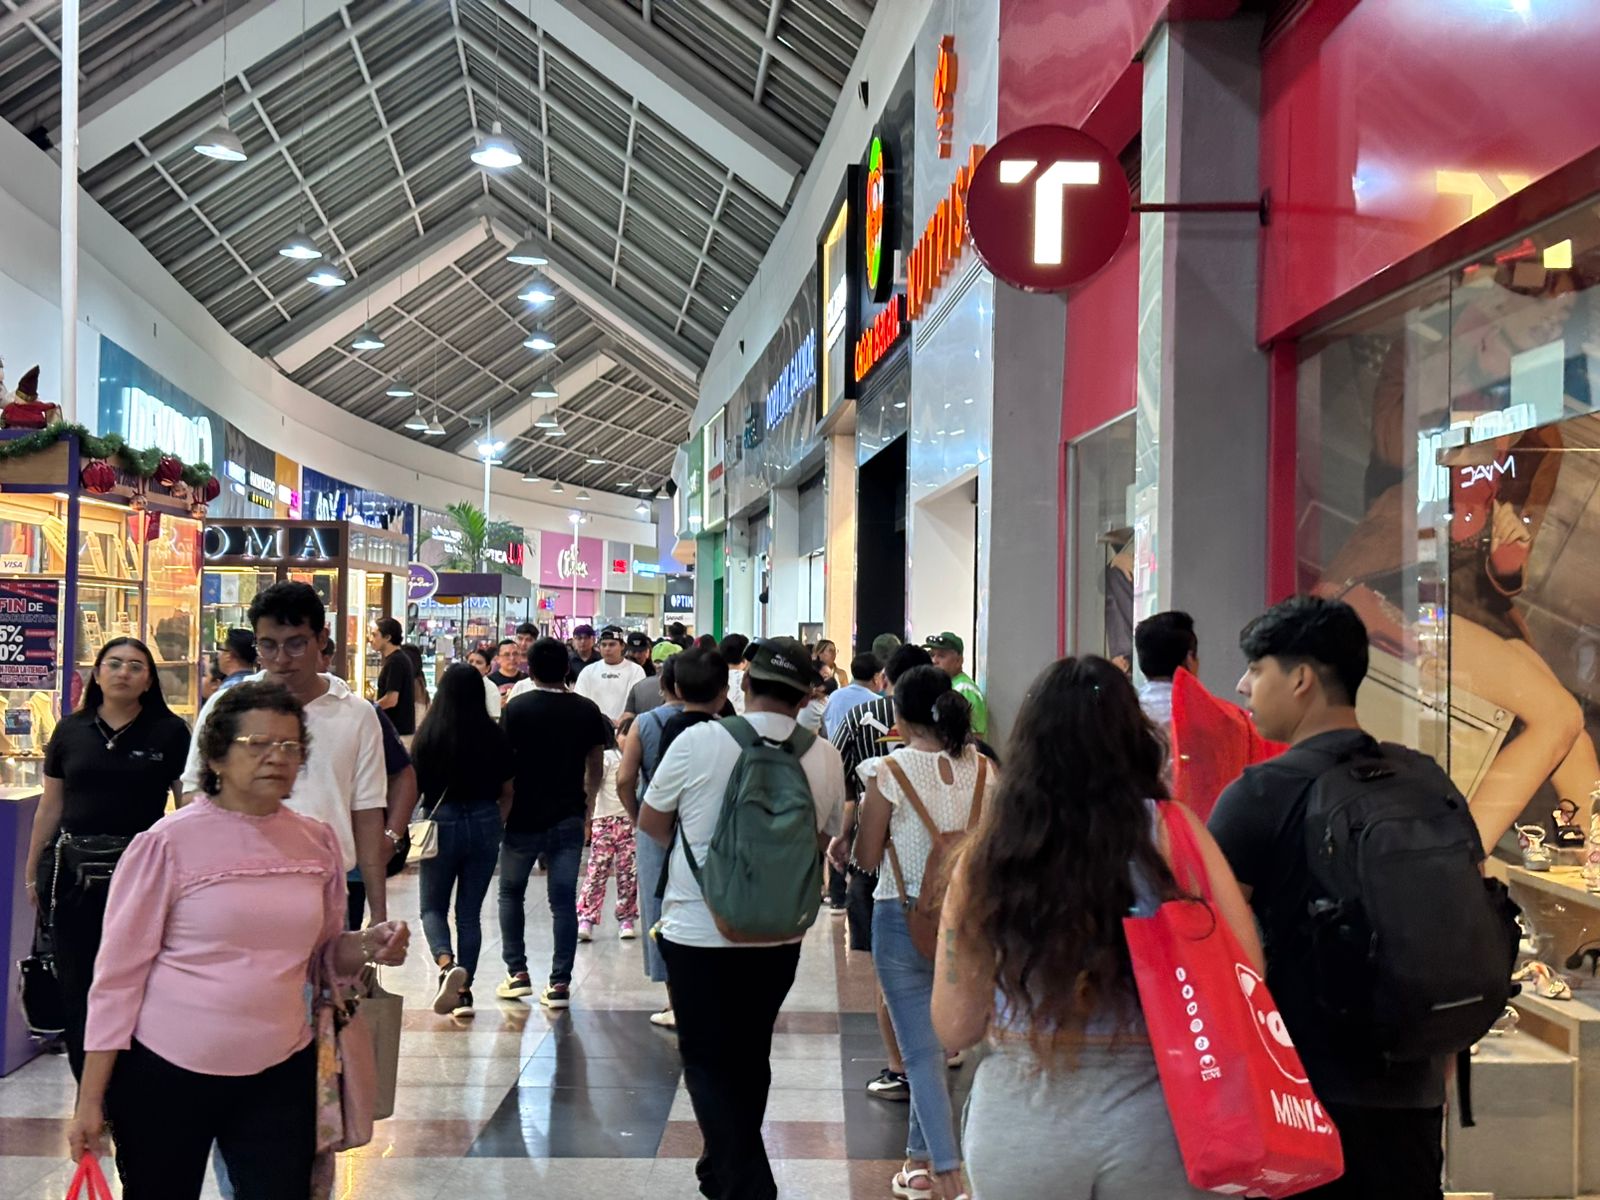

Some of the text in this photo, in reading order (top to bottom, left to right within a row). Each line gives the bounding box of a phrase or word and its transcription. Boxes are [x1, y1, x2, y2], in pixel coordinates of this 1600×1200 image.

[3, 560, 23, 568] VISA
[28, 602, 44, 612] DE
[1270, 1089, 1332, 1134] MINIS
